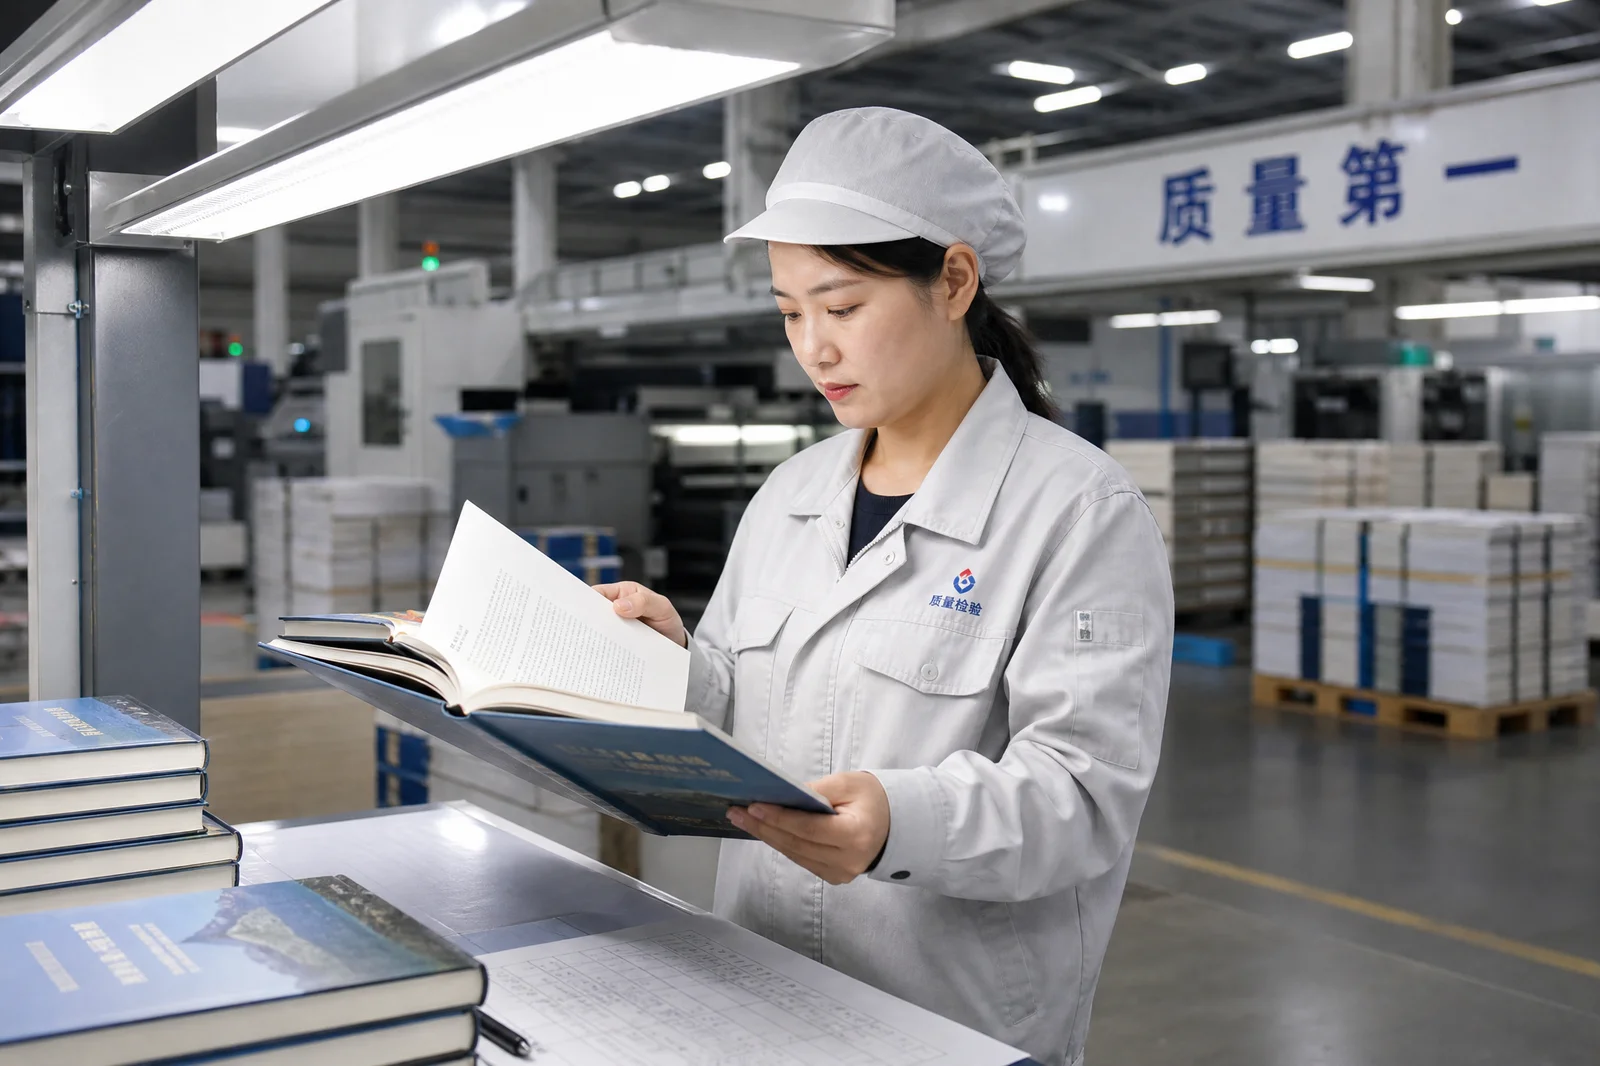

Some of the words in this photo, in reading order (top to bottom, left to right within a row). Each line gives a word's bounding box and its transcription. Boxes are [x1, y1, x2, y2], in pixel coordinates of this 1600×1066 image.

[1158, 138, 1520, 246] 质量第一
[929, 594, 983, 617] 质量检验
